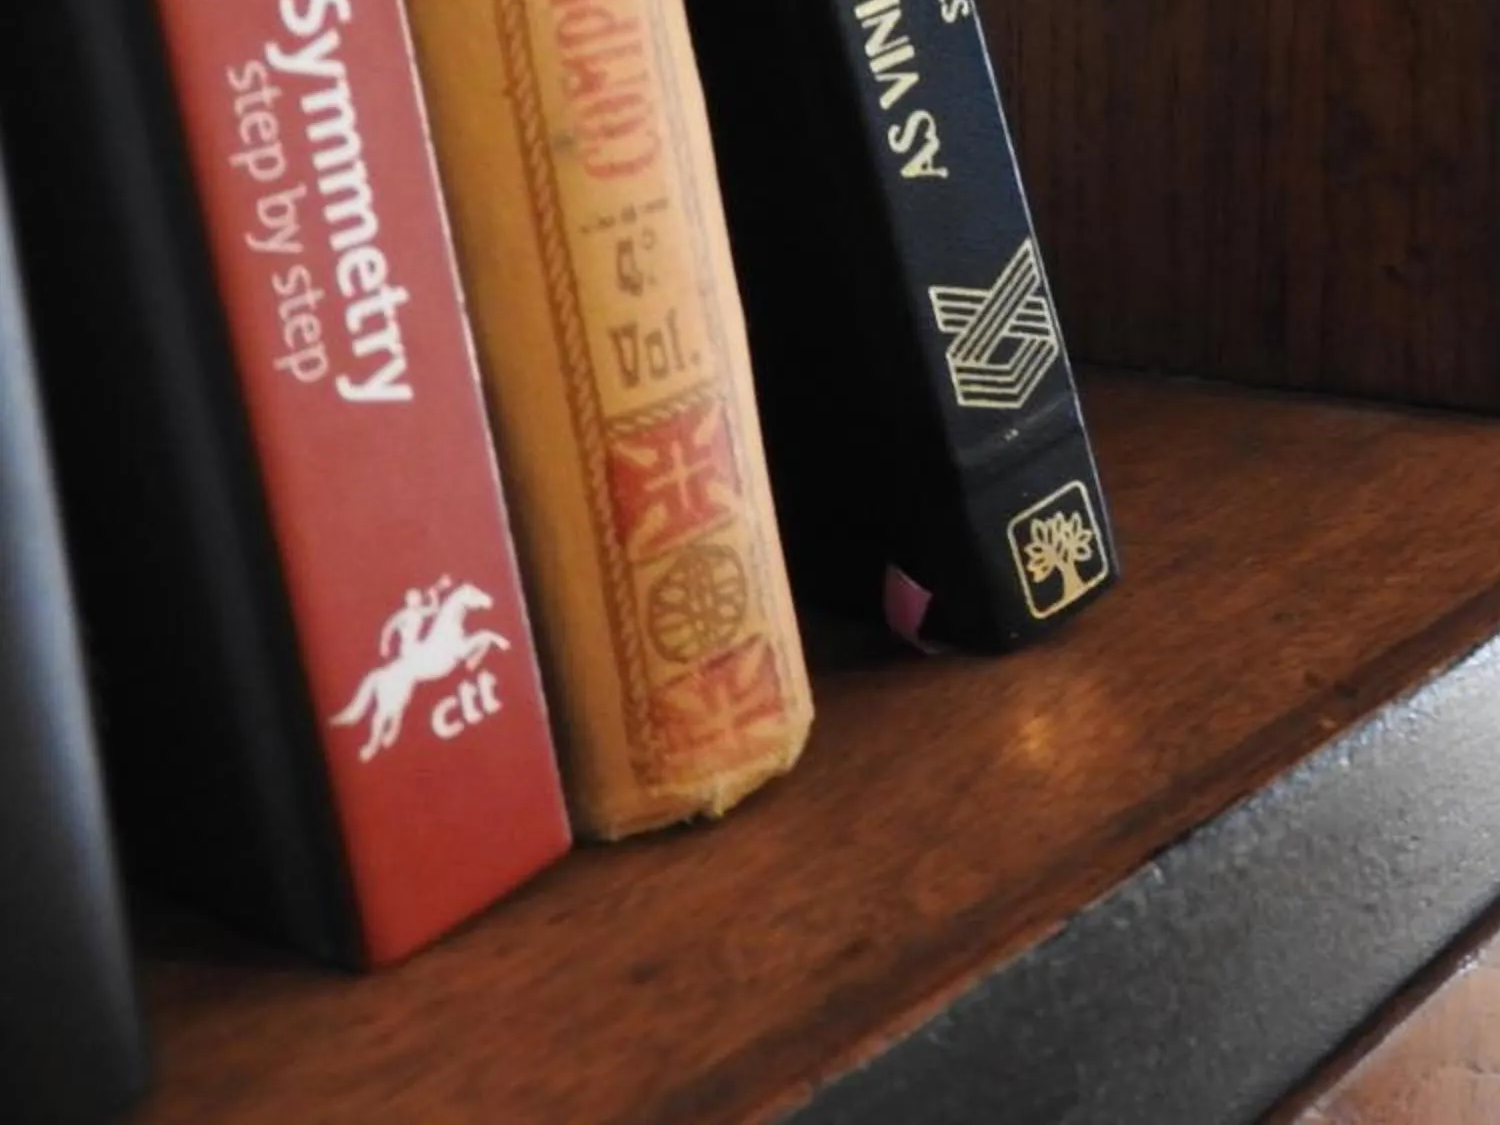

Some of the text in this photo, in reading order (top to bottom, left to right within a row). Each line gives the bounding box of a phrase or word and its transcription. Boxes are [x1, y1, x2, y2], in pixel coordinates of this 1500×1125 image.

[887, 109, 949, 181] AS
[226, 58, 331, 384] step by step
[430, 668, 503, 741] ctt
